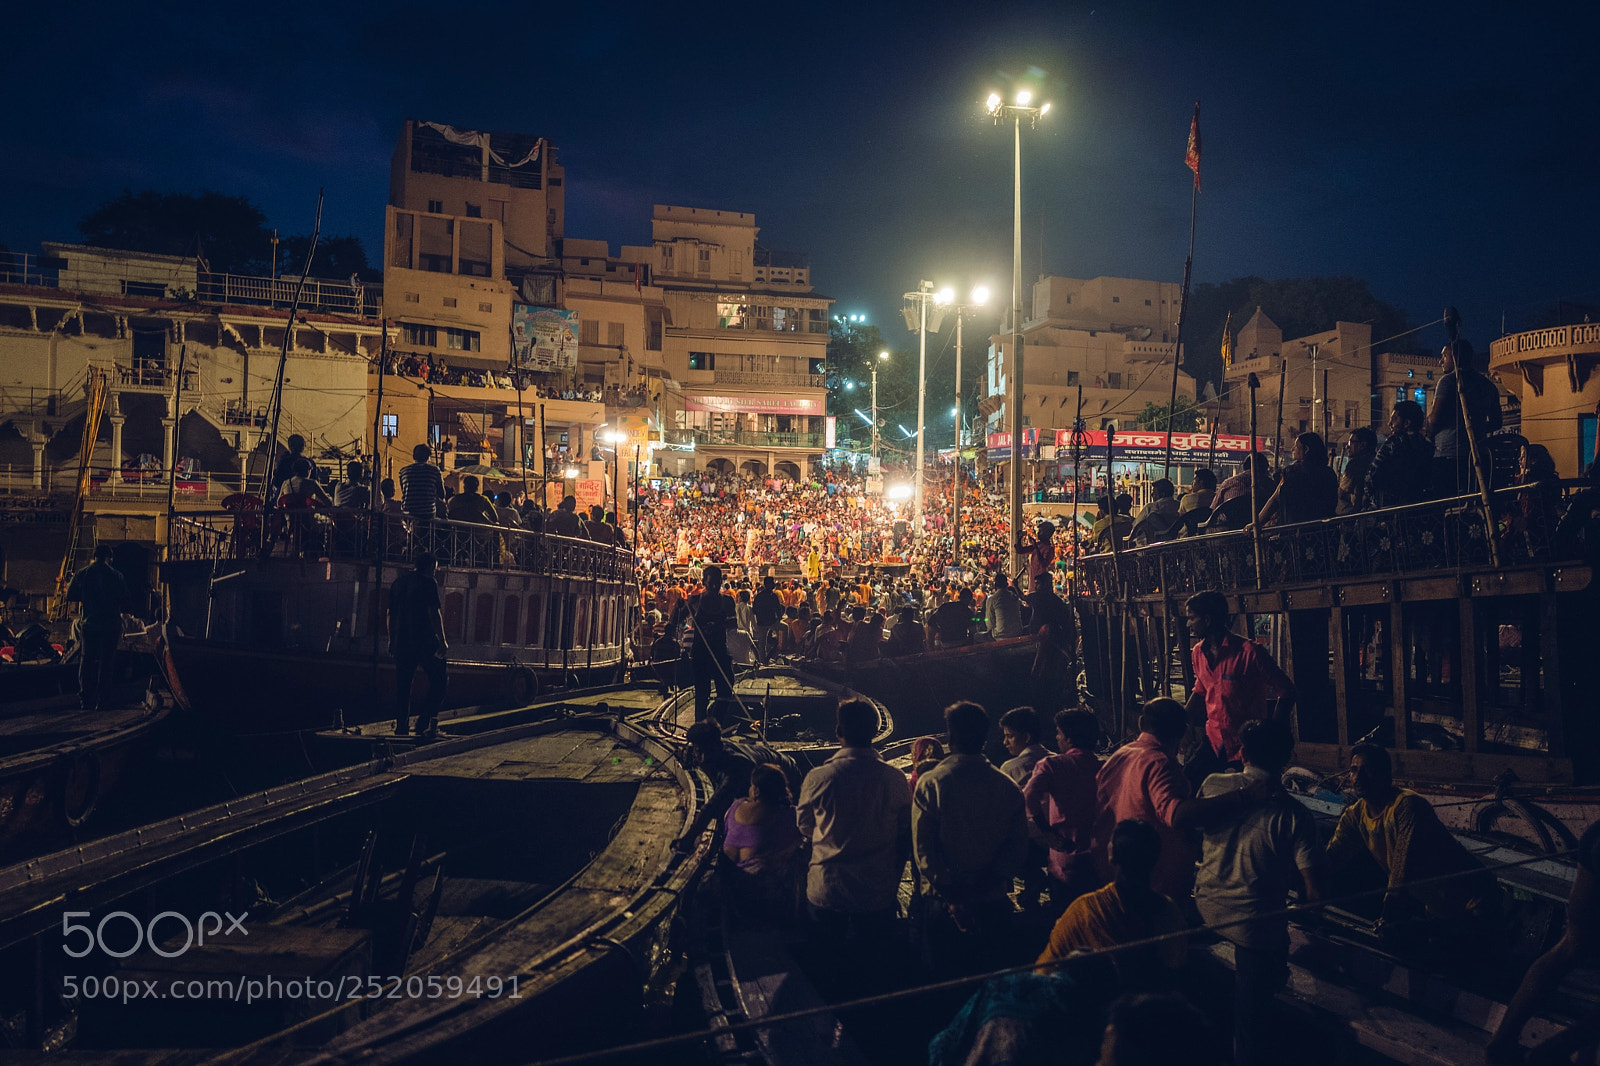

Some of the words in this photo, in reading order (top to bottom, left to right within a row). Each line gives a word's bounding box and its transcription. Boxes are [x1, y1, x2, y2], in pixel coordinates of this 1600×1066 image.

[997, 434, 1006, 446] JAL
[1104, 434, 1164, 446] जल
[1171, 434, 1249, 450] पुलिस
